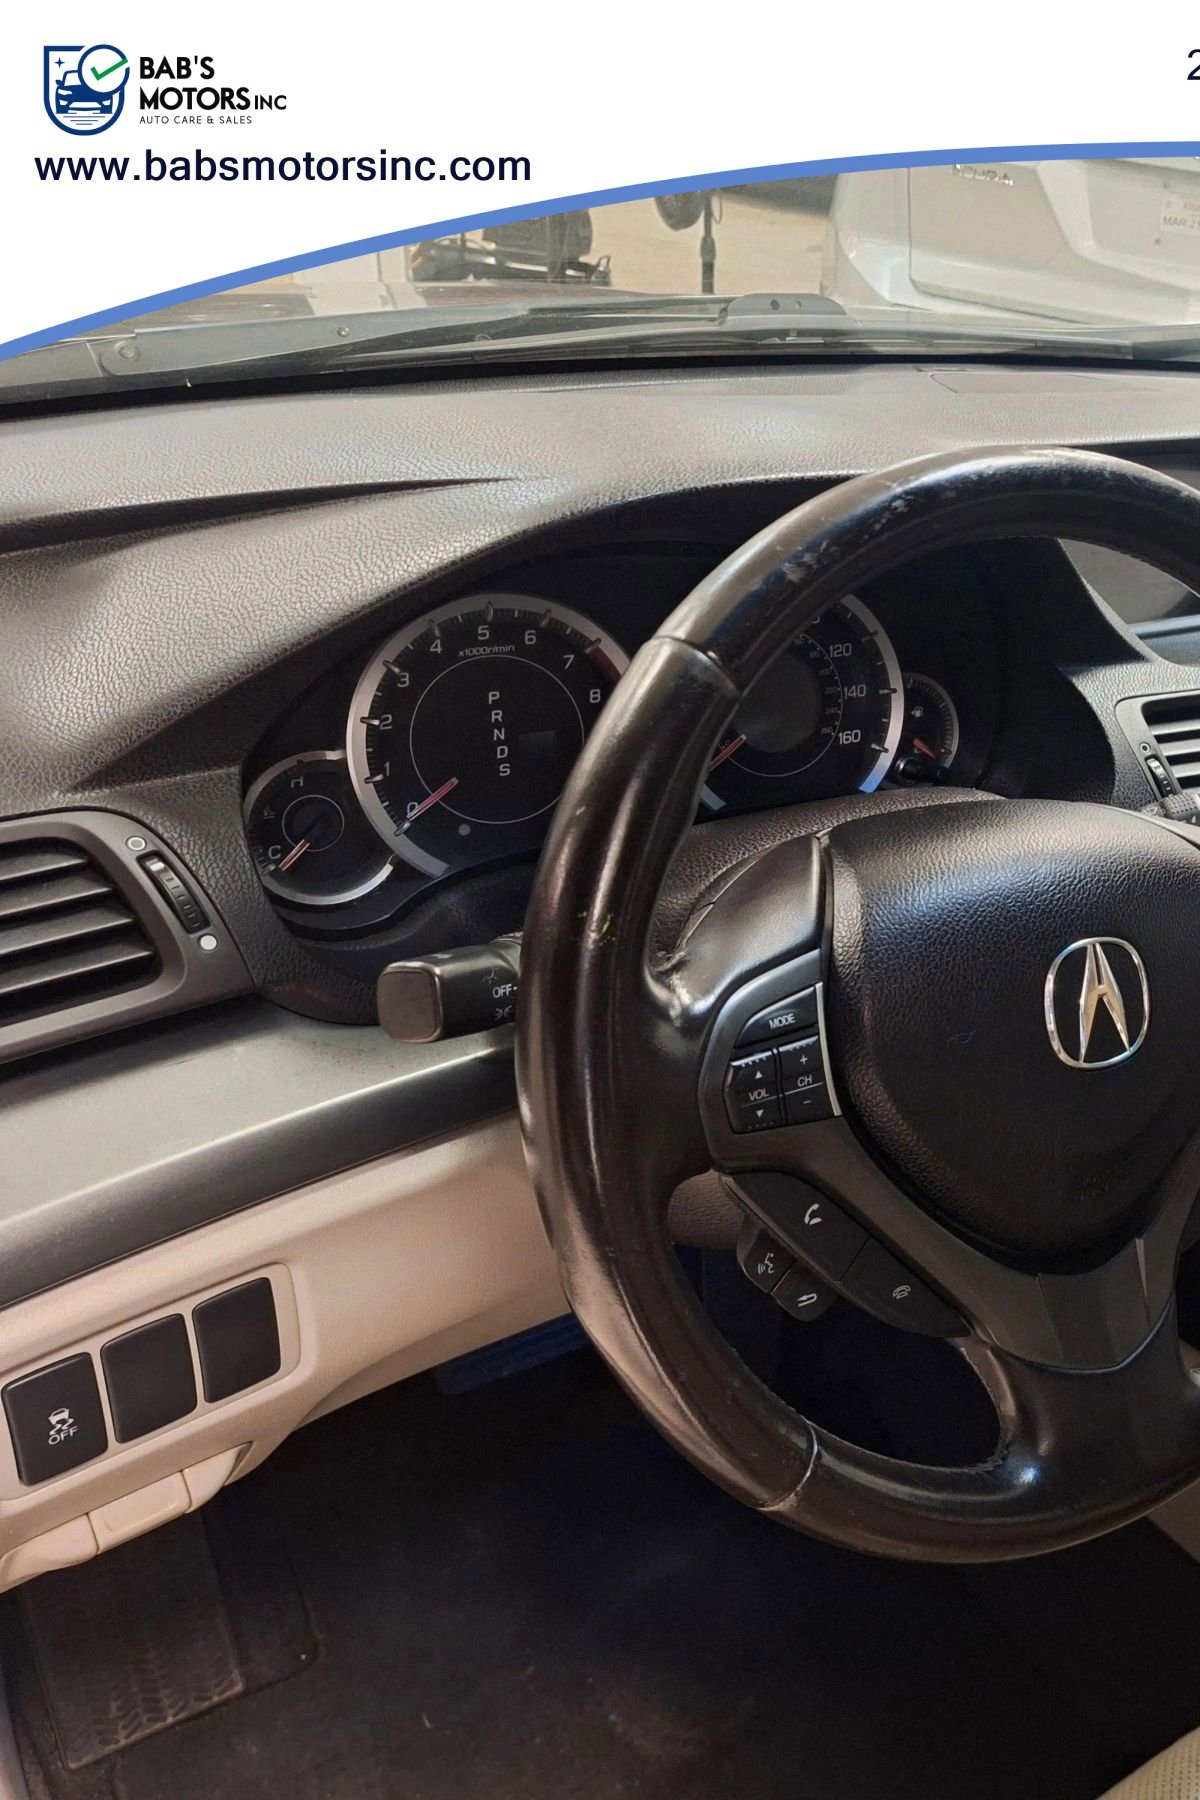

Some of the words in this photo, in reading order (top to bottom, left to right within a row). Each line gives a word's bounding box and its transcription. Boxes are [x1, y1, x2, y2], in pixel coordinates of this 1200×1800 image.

[478, 625, 489, 640] 5
[525, 631, 536, 644] 6
[430, 639, 442, 654] 4
[829, 643, 852, 657] 120
[563, 655, 575, 669] 7
[398, 672, 410, 687] 3
[489, 692, 500, 704] P
[590, 690, 601, 703] 8
[843, 684, 867, 700] 140
[380, 715, 392, 730] 2
[491, 710, 503, 723] R
[494, 728, 505, 741] N
[838, 729, 861, 745] 160
[497, 746, 508, 759] D
[384, 762, 390, 776] 1
[499, 764, 511, 776] S
[269, 845, 281, 859] C
[492, 984, 512, 998] OFF
[769, 1013, 796, 1029] MODE
[797, 1074, 813, 1087] CH
[748, 1089, 770, 1101] VOL
[48, 1425, 78, 1444] OFF
